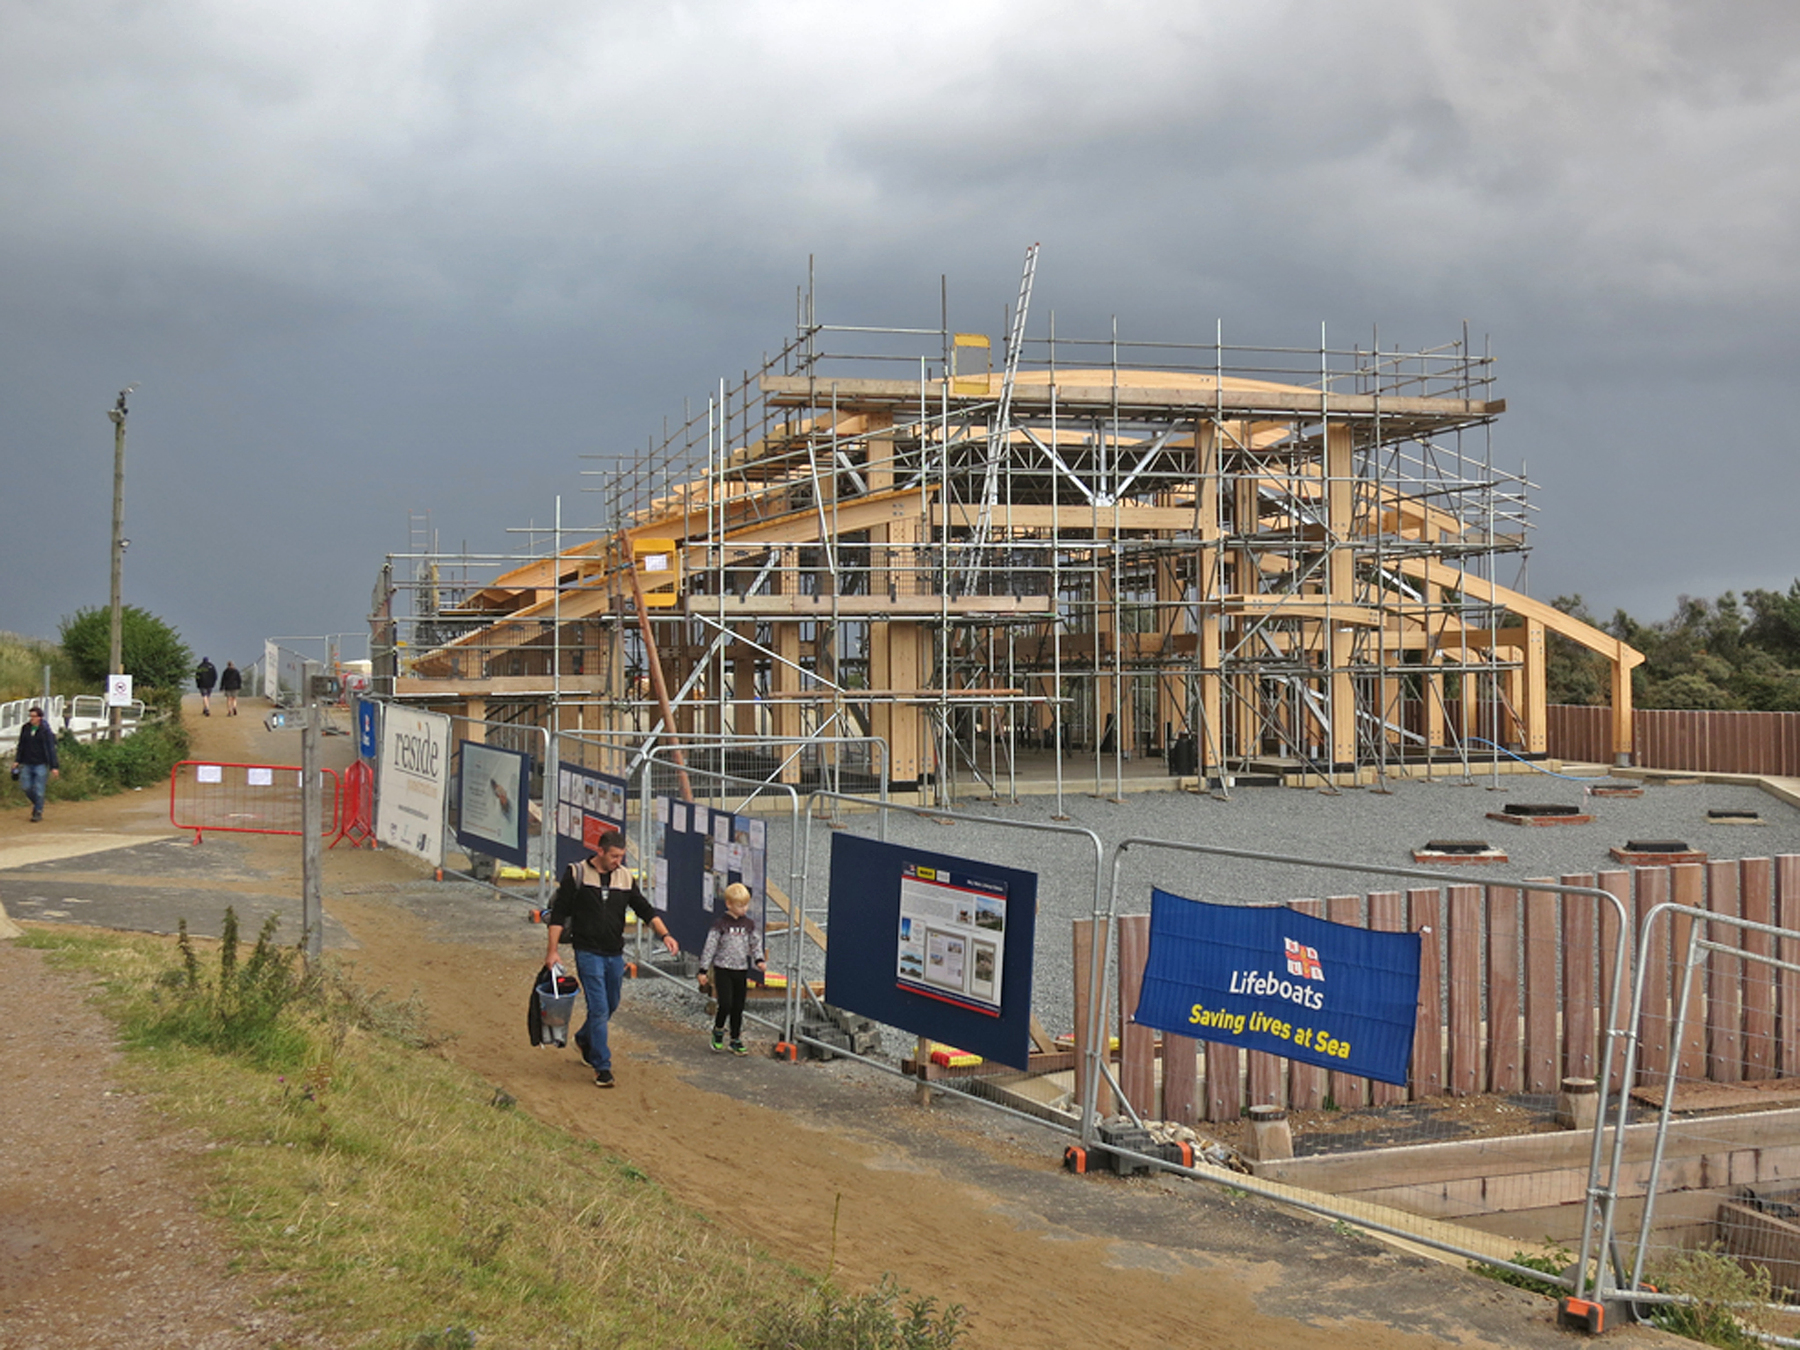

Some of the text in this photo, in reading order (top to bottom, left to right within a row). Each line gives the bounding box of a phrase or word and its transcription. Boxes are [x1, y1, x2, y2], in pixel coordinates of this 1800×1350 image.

[394, 721, 439, 778] reside
[1229, 970, 1325, 1010] Lifeboats
[1188, 1004, 1351, 1059] Saving lives at Sea
